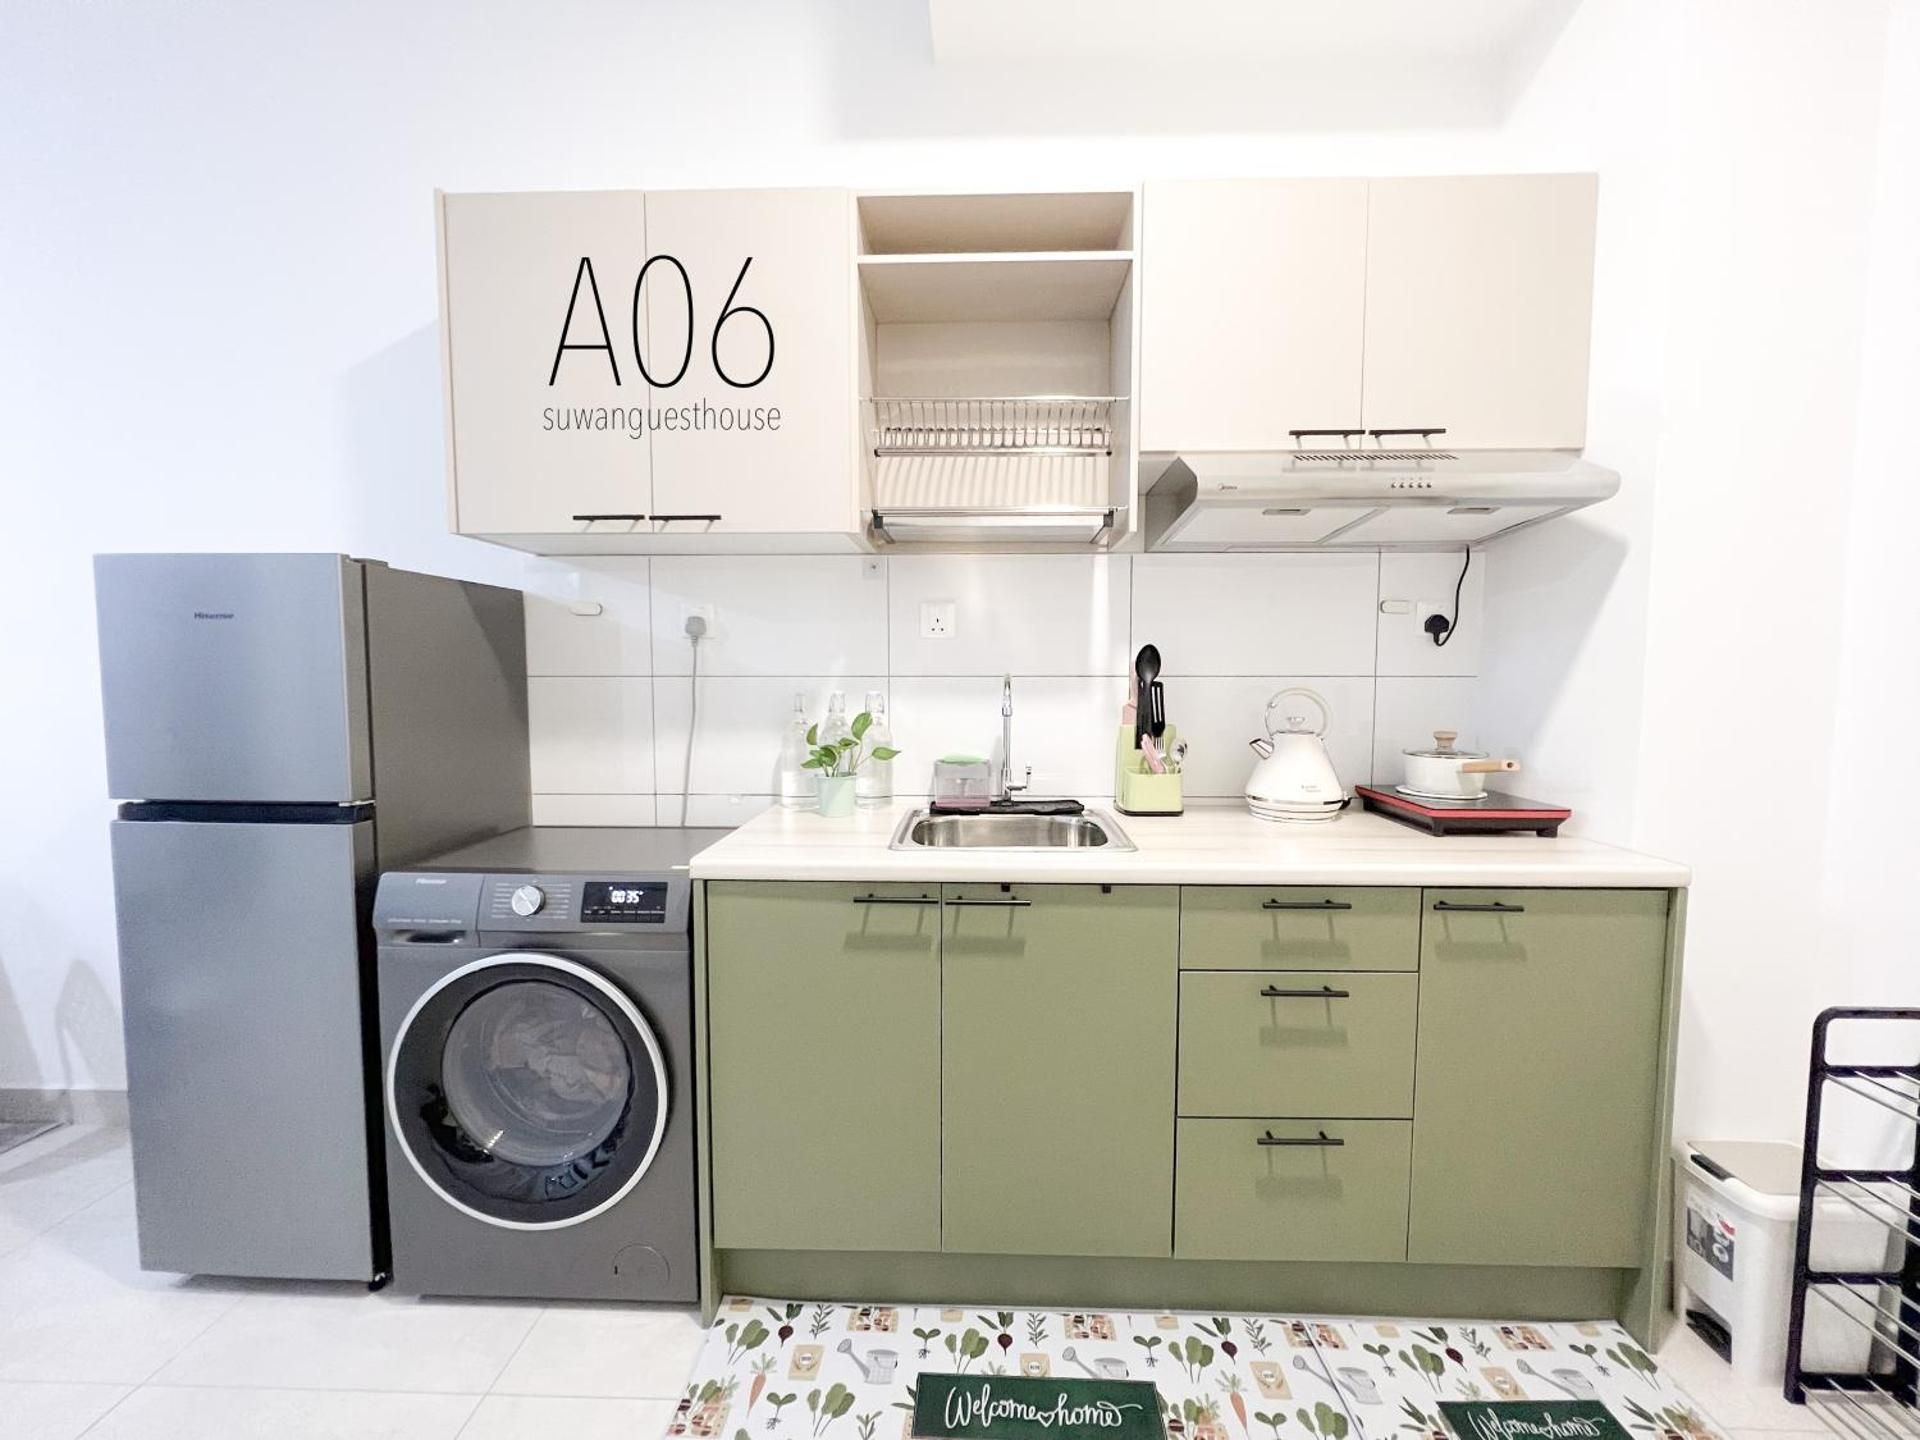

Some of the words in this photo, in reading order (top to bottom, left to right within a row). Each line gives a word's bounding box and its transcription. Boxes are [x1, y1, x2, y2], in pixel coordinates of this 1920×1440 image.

[945, 1383, 1037, 1429] Welcome
[1057, 1392, 1144, 1428] home
[1467, 1407, 1540, 1440] Welcome
[1543, 1412, 1606, 1439] home
